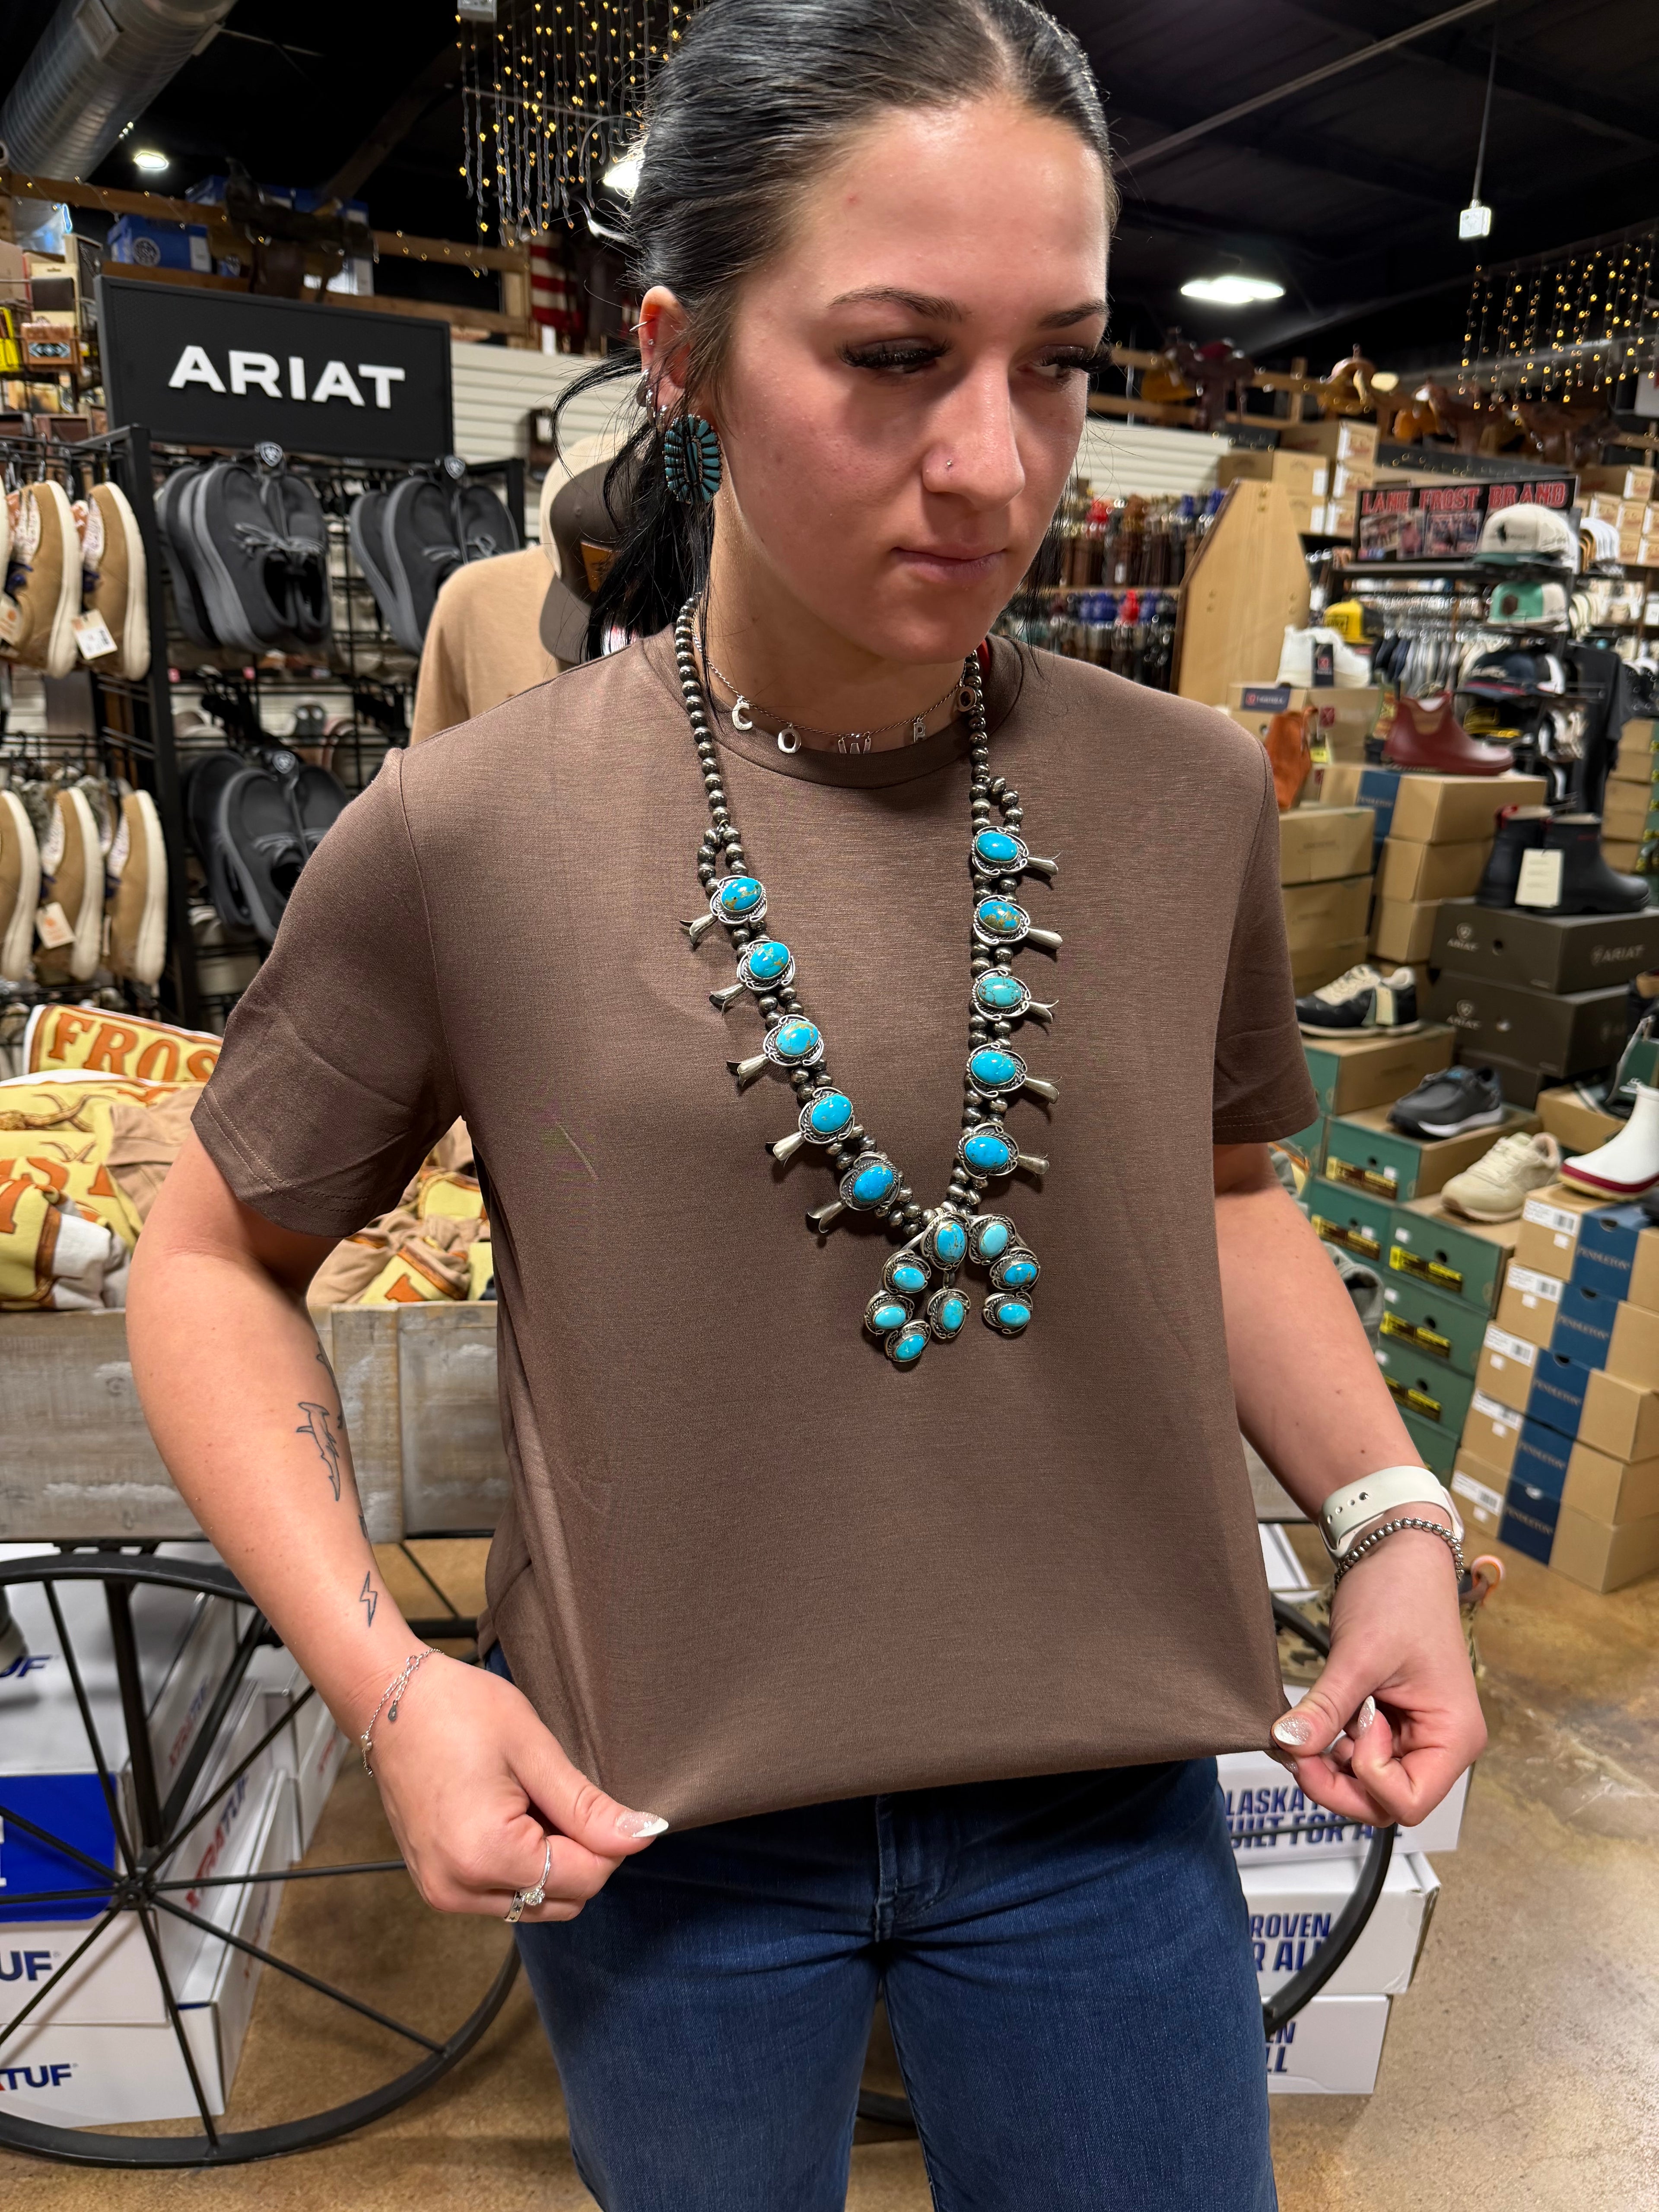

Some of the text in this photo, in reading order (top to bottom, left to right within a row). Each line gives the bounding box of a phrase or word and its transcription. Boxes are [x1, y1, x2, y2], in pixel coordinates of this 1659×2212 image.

[168, 345, 405, 409] ARIAT
[1362, 481, 1566, 515] LANE FROST BRAND
[1577, 1244, 1627, 1271] PENDLETON
[1556, 1313, 1606, 1340] PENDLETON
[1225, 1786, 1304, 1816] LASKA
[1227, 1815, 1284, 1849] UILT
[1250, 1913, 1331, 1939] ROVEN
[1272, 1939, 1323, 1971] AL
[0, 2063, 72, 2091] TUF
